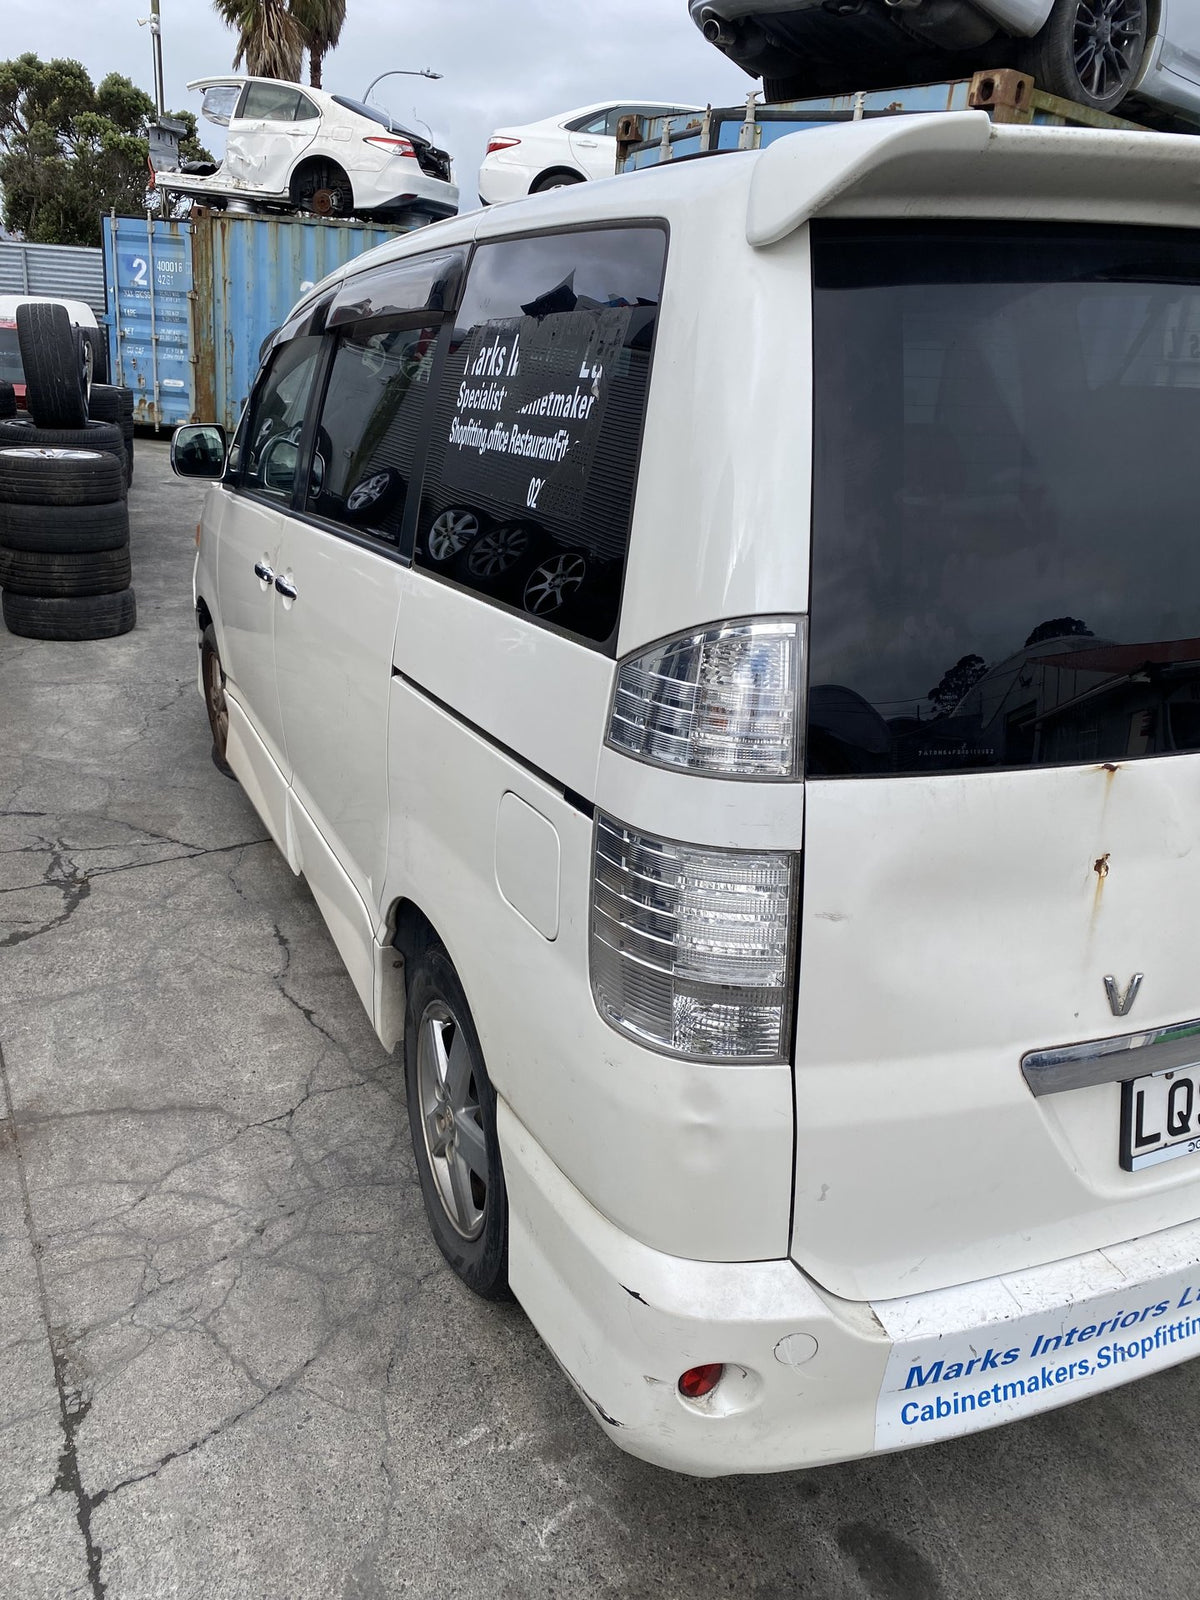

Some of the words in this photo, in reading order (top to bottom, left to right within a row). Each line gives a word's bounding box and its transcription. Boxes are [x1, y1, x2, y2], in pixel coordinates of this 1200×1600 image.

[132, 258, 147, 286] 2
[456, 380, 508, 414] Specialist
[526, 477, 546, 509] 02
[1134, 1078, 1200, 1149] LQ
[904, 1344, 1021, 1390] Marks
[1030, 1298, 1170, 1357] Interiors
